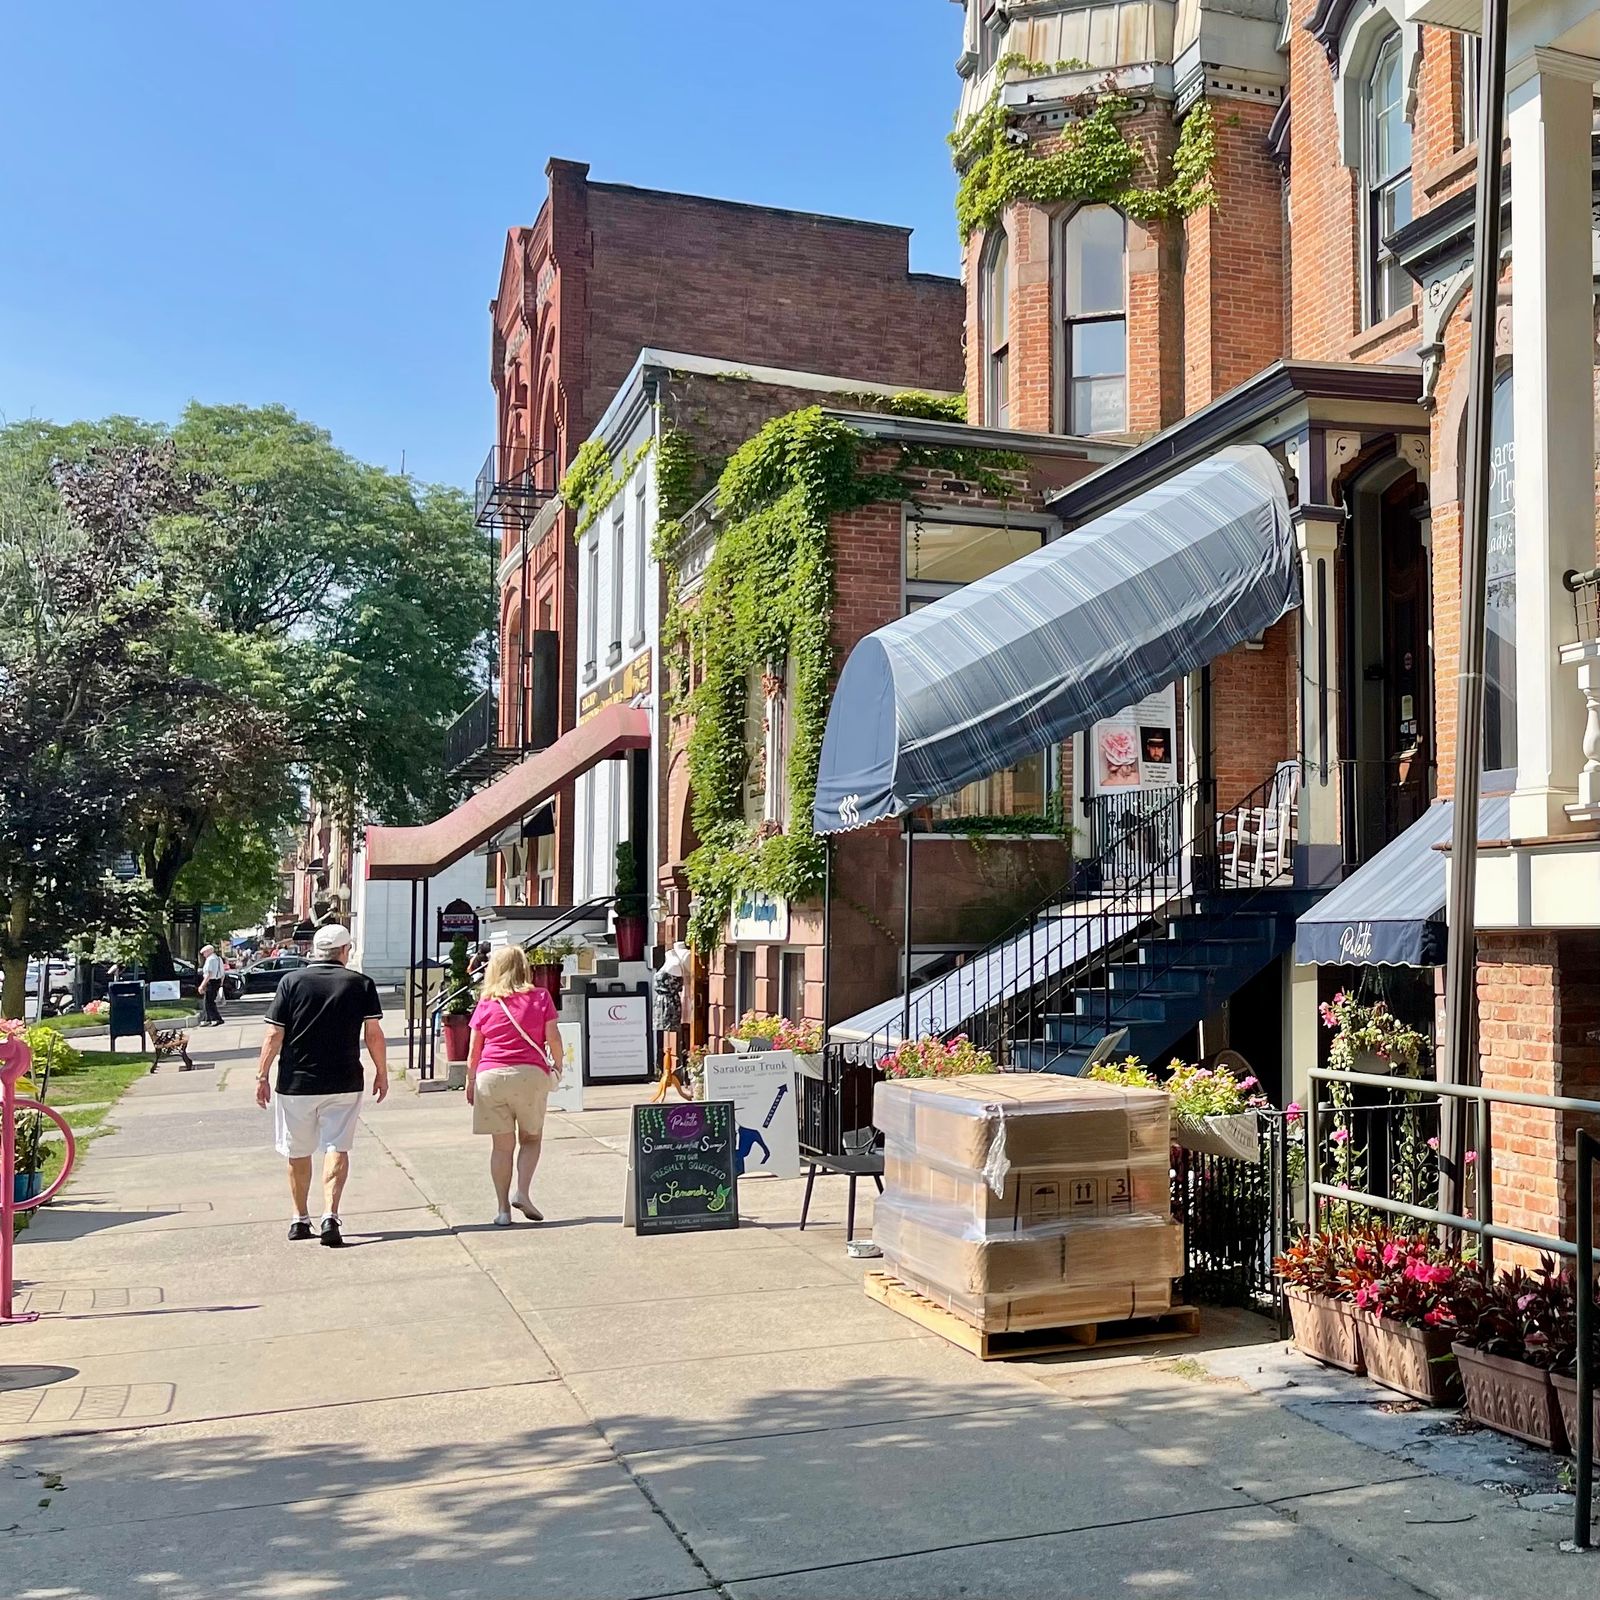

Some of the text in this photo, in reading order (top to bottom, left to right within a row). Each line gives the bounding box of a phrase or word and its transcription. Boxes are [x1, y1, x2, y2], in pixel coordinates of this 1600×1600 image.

[1488, 525, 1513, 555] ady's
[1340, 922, 1371, 963] Palette
[712, 1061, 788, 1074] Saratoga Trunk
[650, 1161, 726, 1182] FRESHLY SQUEEZED
